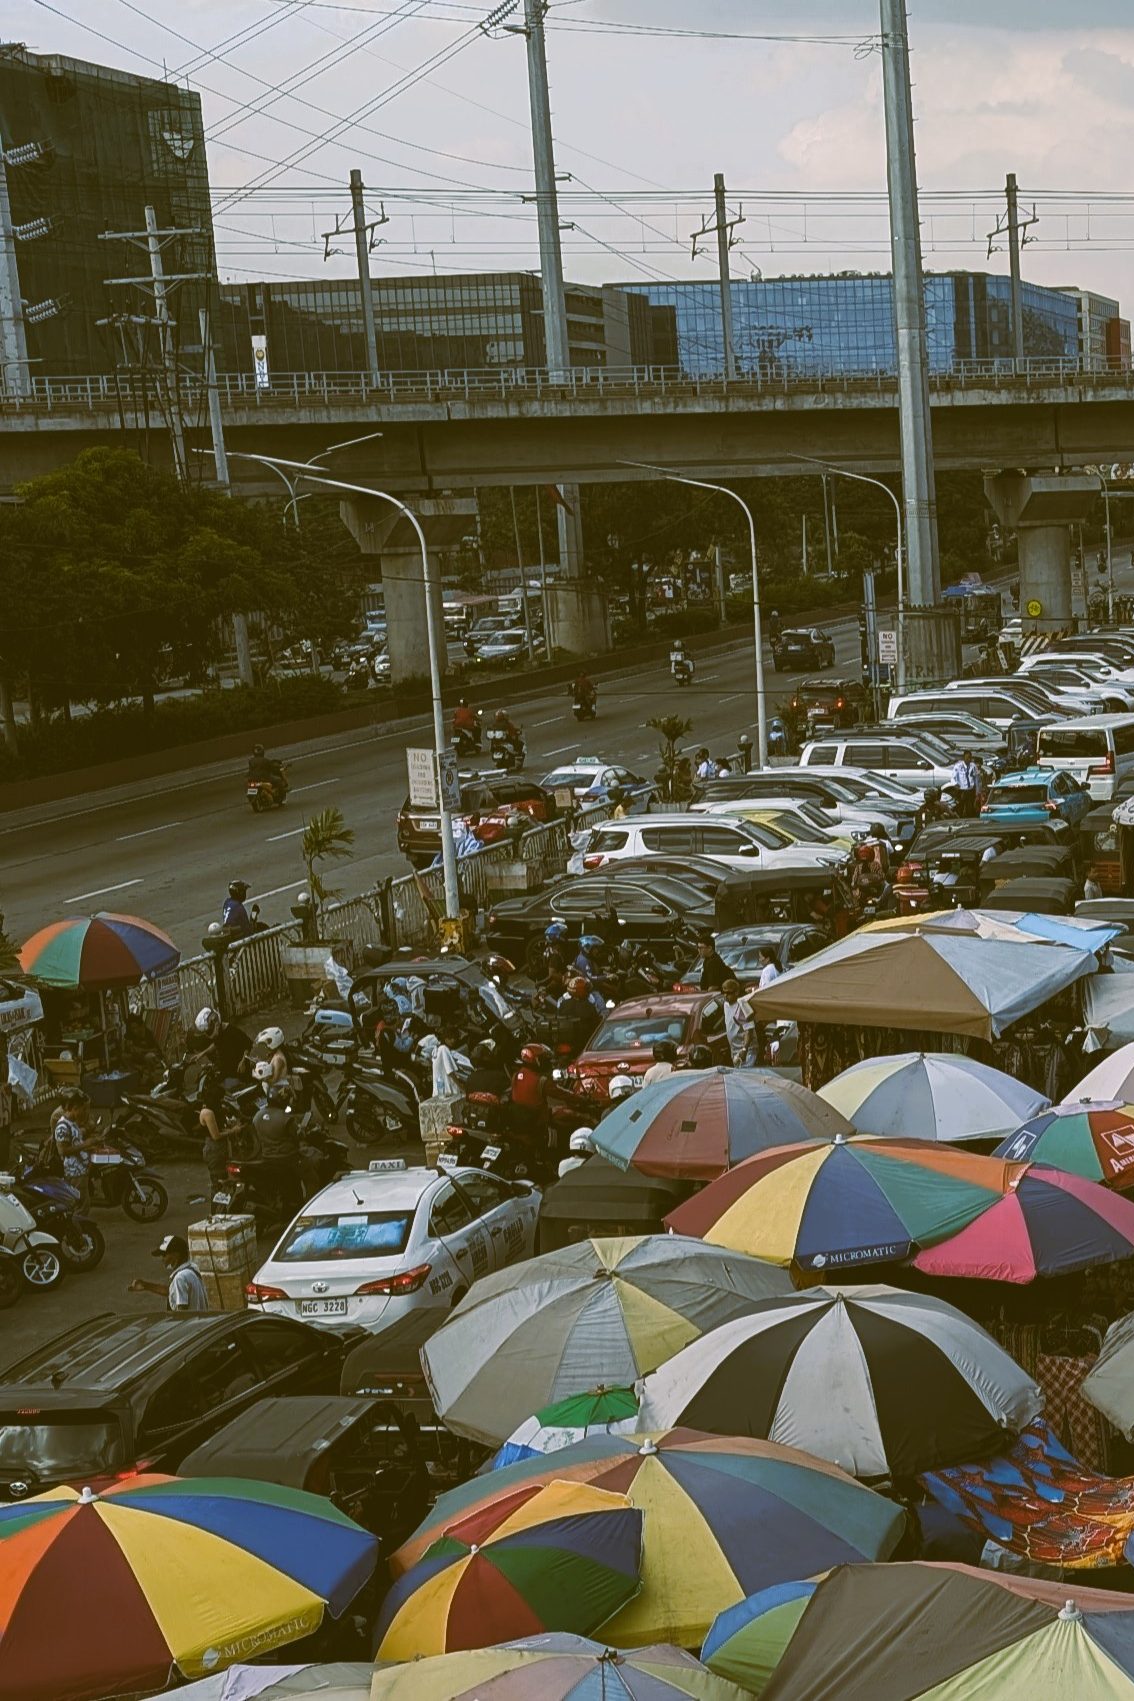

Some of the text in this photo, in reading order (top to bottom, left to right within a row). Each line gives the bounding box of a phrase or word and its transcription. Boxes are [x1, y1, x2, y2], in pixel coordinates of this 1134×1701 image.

[413, 753, 426, 762] NO
[374, 1161, 401, 1169] TAXI
[830, 1245, 897, 1264] MICROMATIC
[302, 1303, 318, 1313] NGC
[224, 1616, 310, 1658] MICROMATIC
